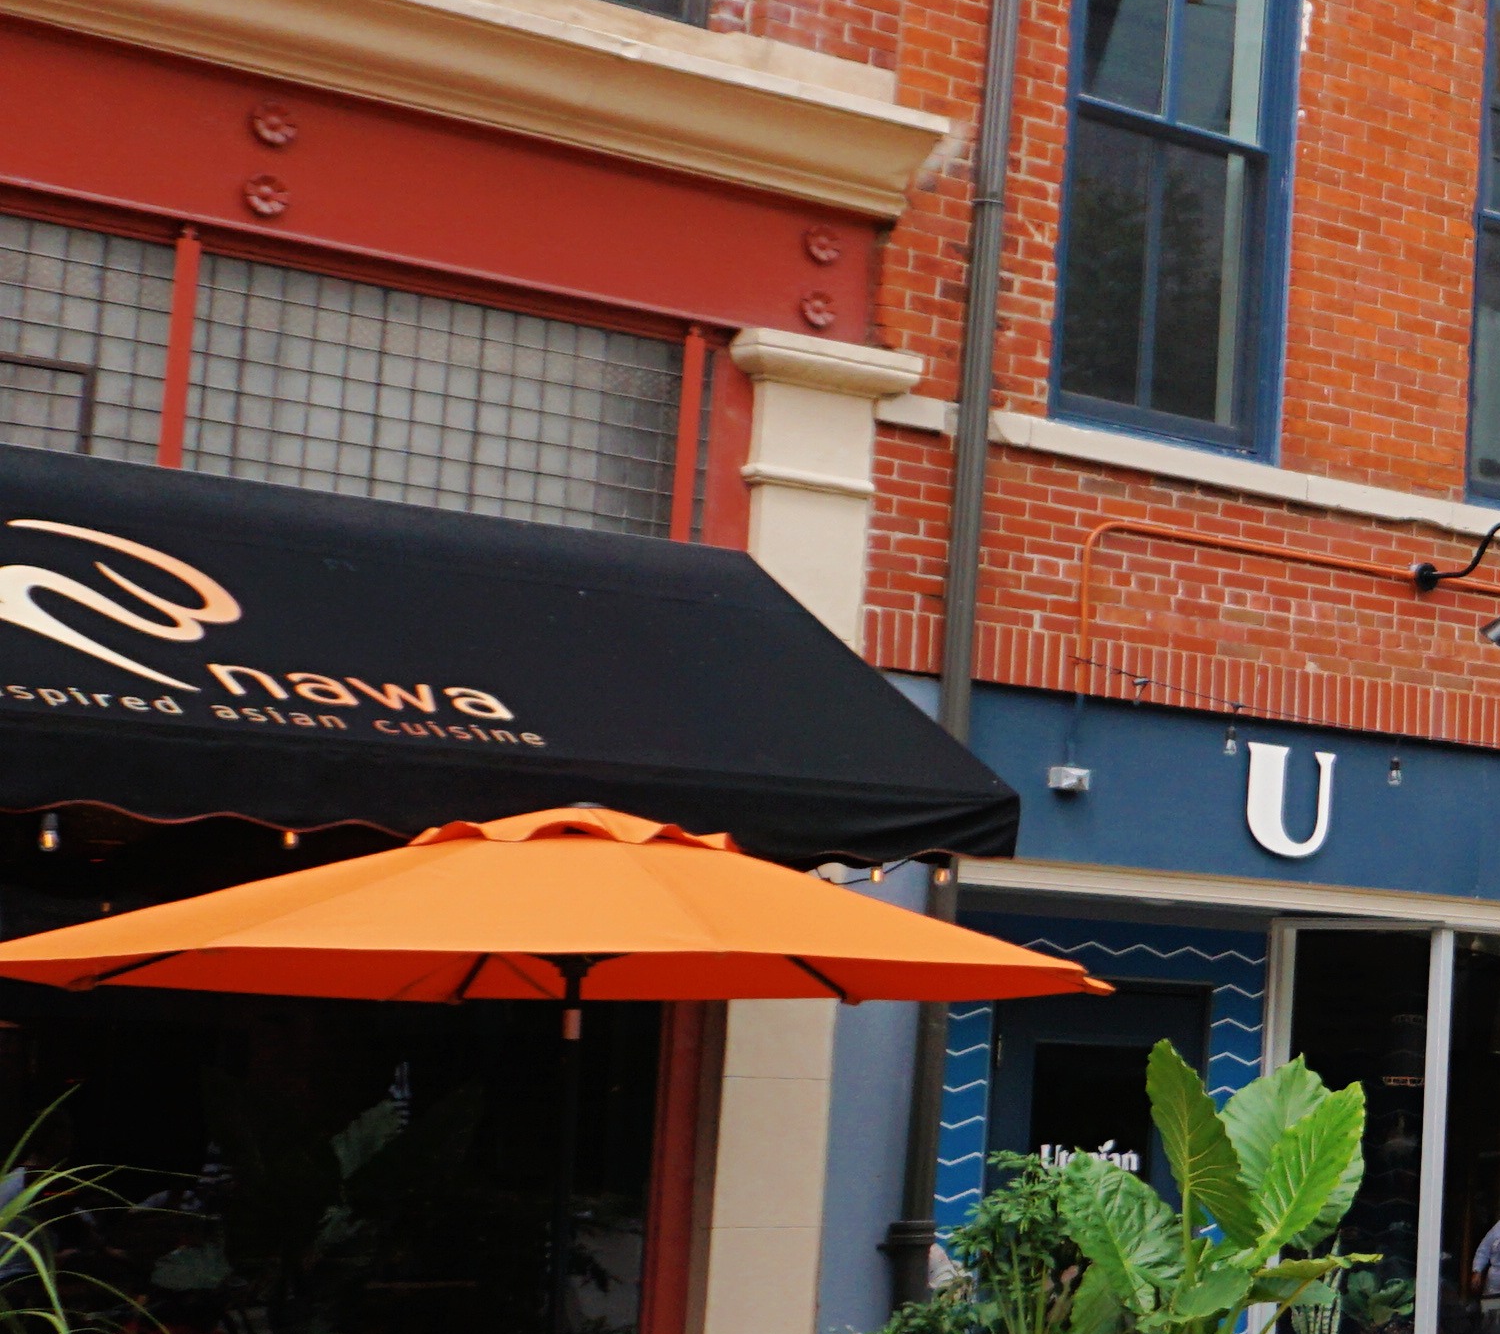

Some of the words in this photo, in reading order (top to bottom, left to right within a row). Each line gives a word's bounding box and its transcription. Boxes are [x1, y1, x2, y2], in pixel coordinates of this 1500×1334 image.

[0, 681, 185, 716] spired
[209, 703, 348, 731] asian
[371, 716, 547, 748] cuisine
[205, 662, 515, 721] nawa
